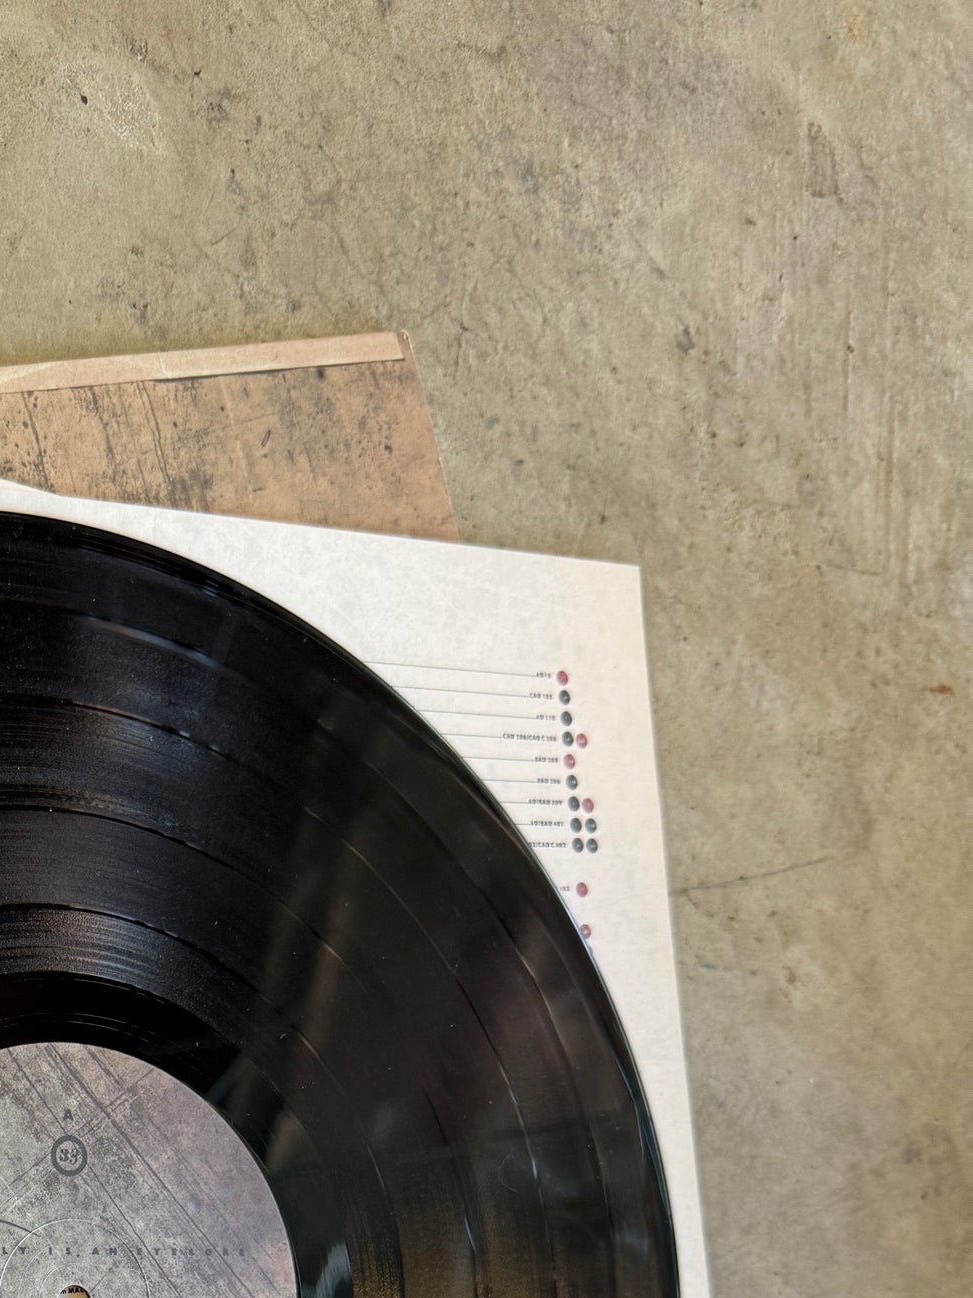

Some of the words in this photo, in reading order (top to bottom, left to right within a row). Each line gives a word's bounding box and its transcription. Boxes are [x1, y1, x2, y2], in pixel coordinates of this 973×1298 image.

[62, 1108, 74, 1121] A
[48, 1247, 72, 1255] IS
[91, 1247, 118, 1256] AN
